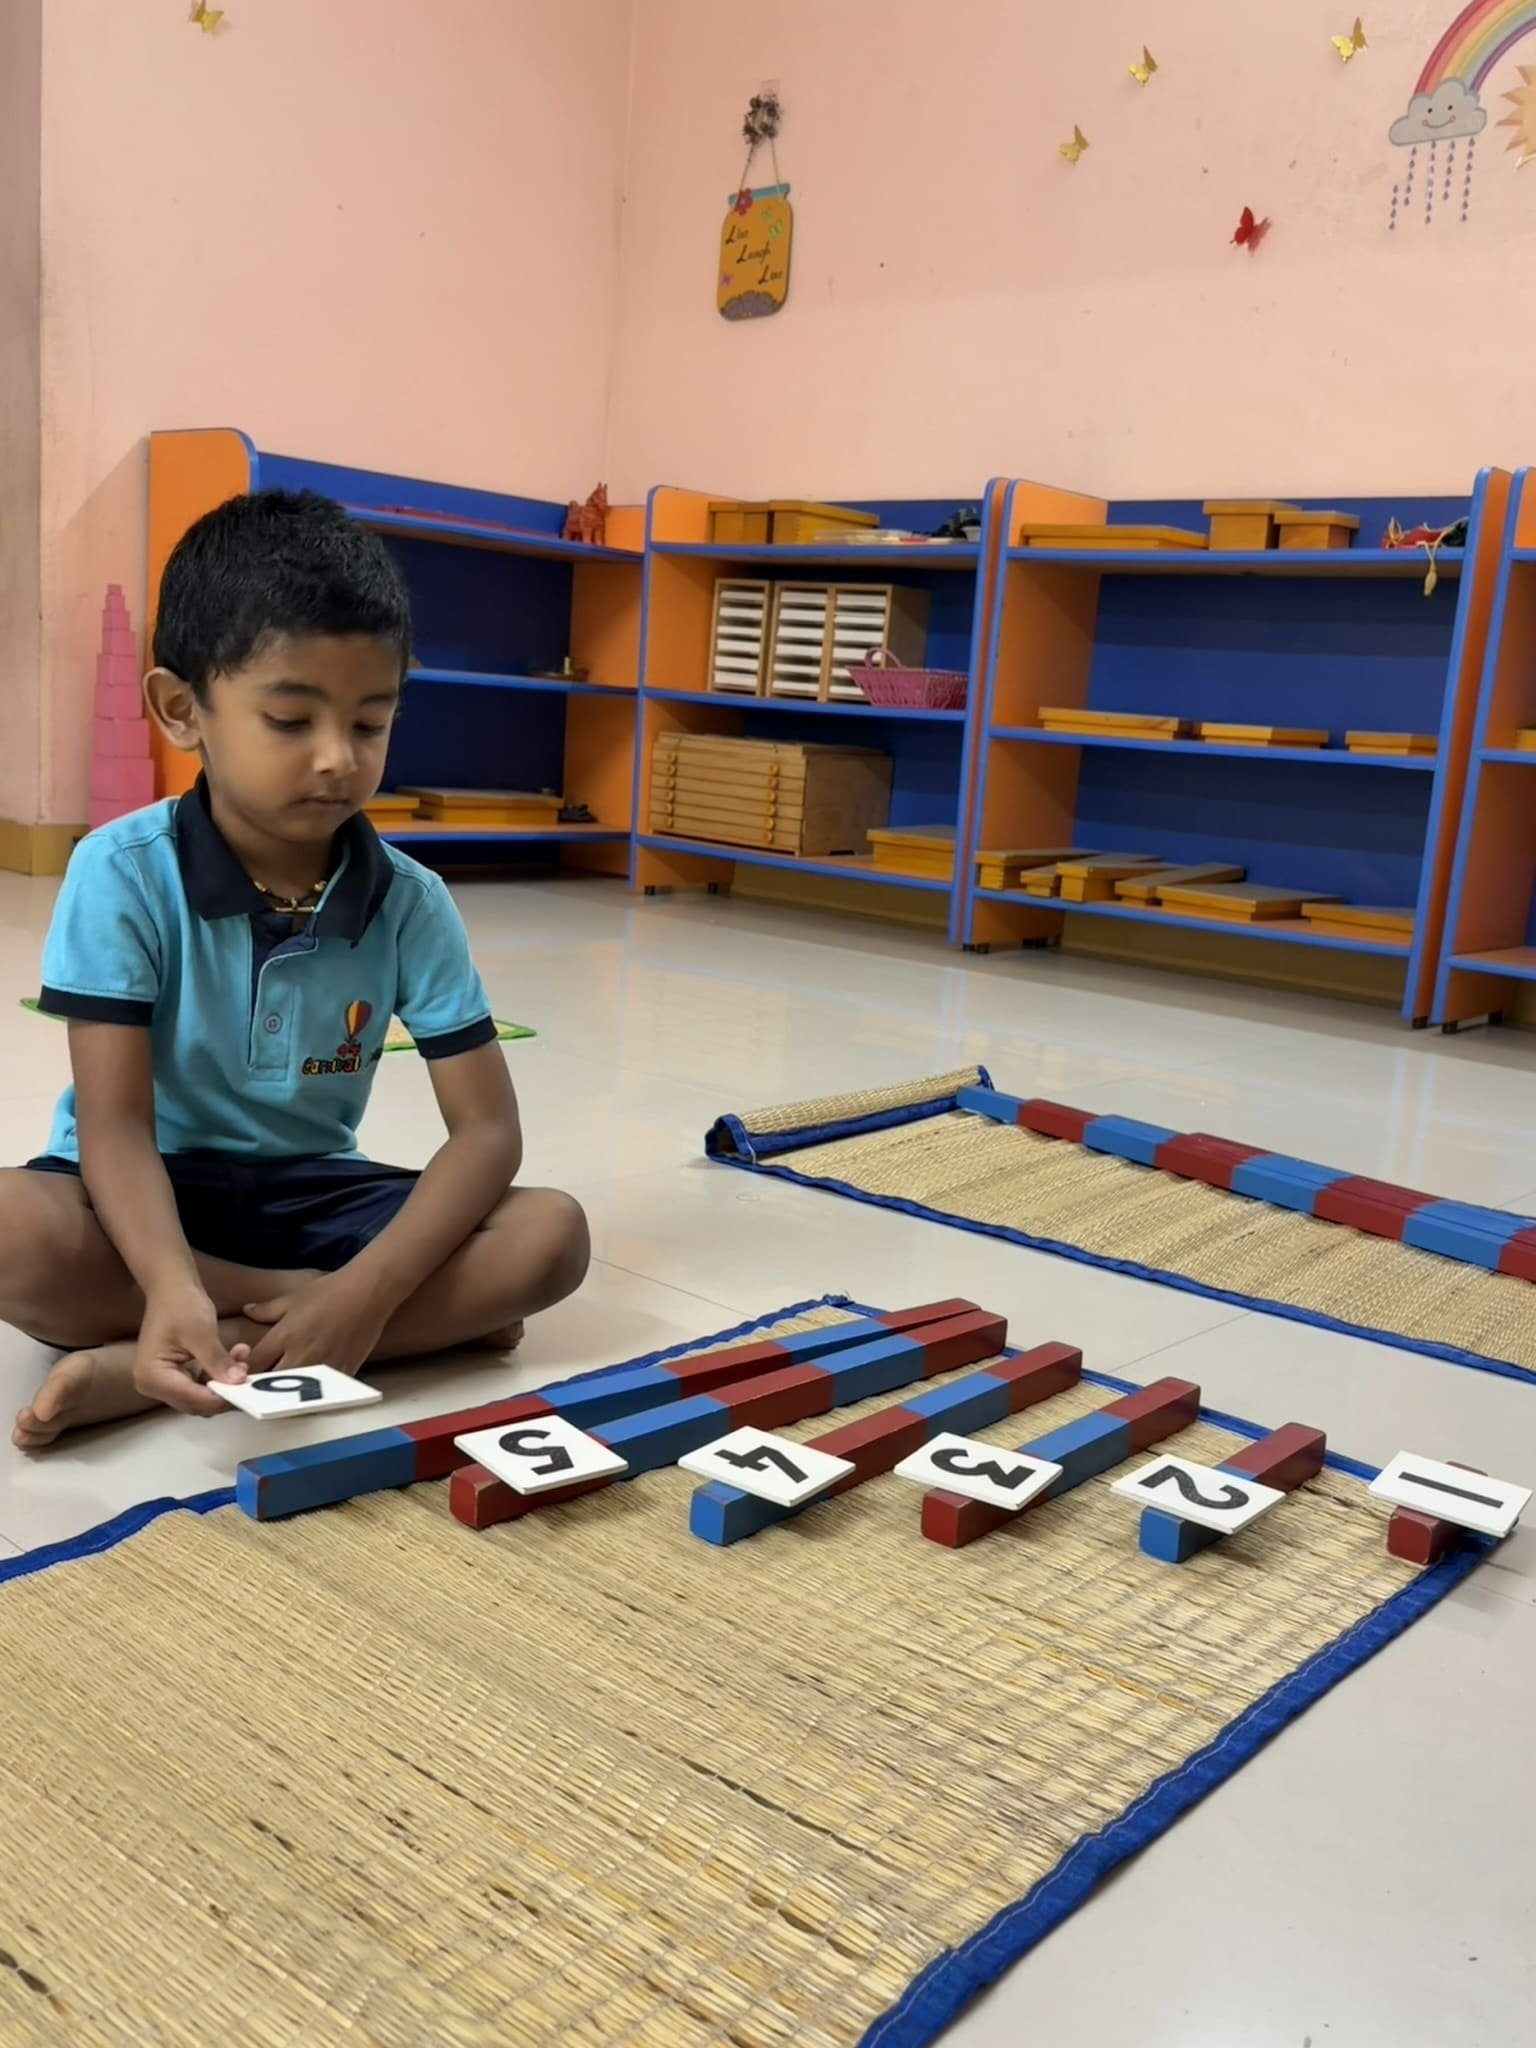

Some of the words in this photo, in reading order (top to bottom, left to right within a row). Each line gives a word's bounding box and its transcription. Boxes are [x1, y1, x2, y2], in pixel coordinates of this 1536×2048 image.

[251, 1375, 323, 1402] 6
[498, 1429, 574, 1476] 5
[714, 1445, 808, 1484] 4
[930, 1448, 1036, 1490] 3
[1138, 1465, 1249, 1510] 2
[1398, 1472, 1504, 1509] 1
